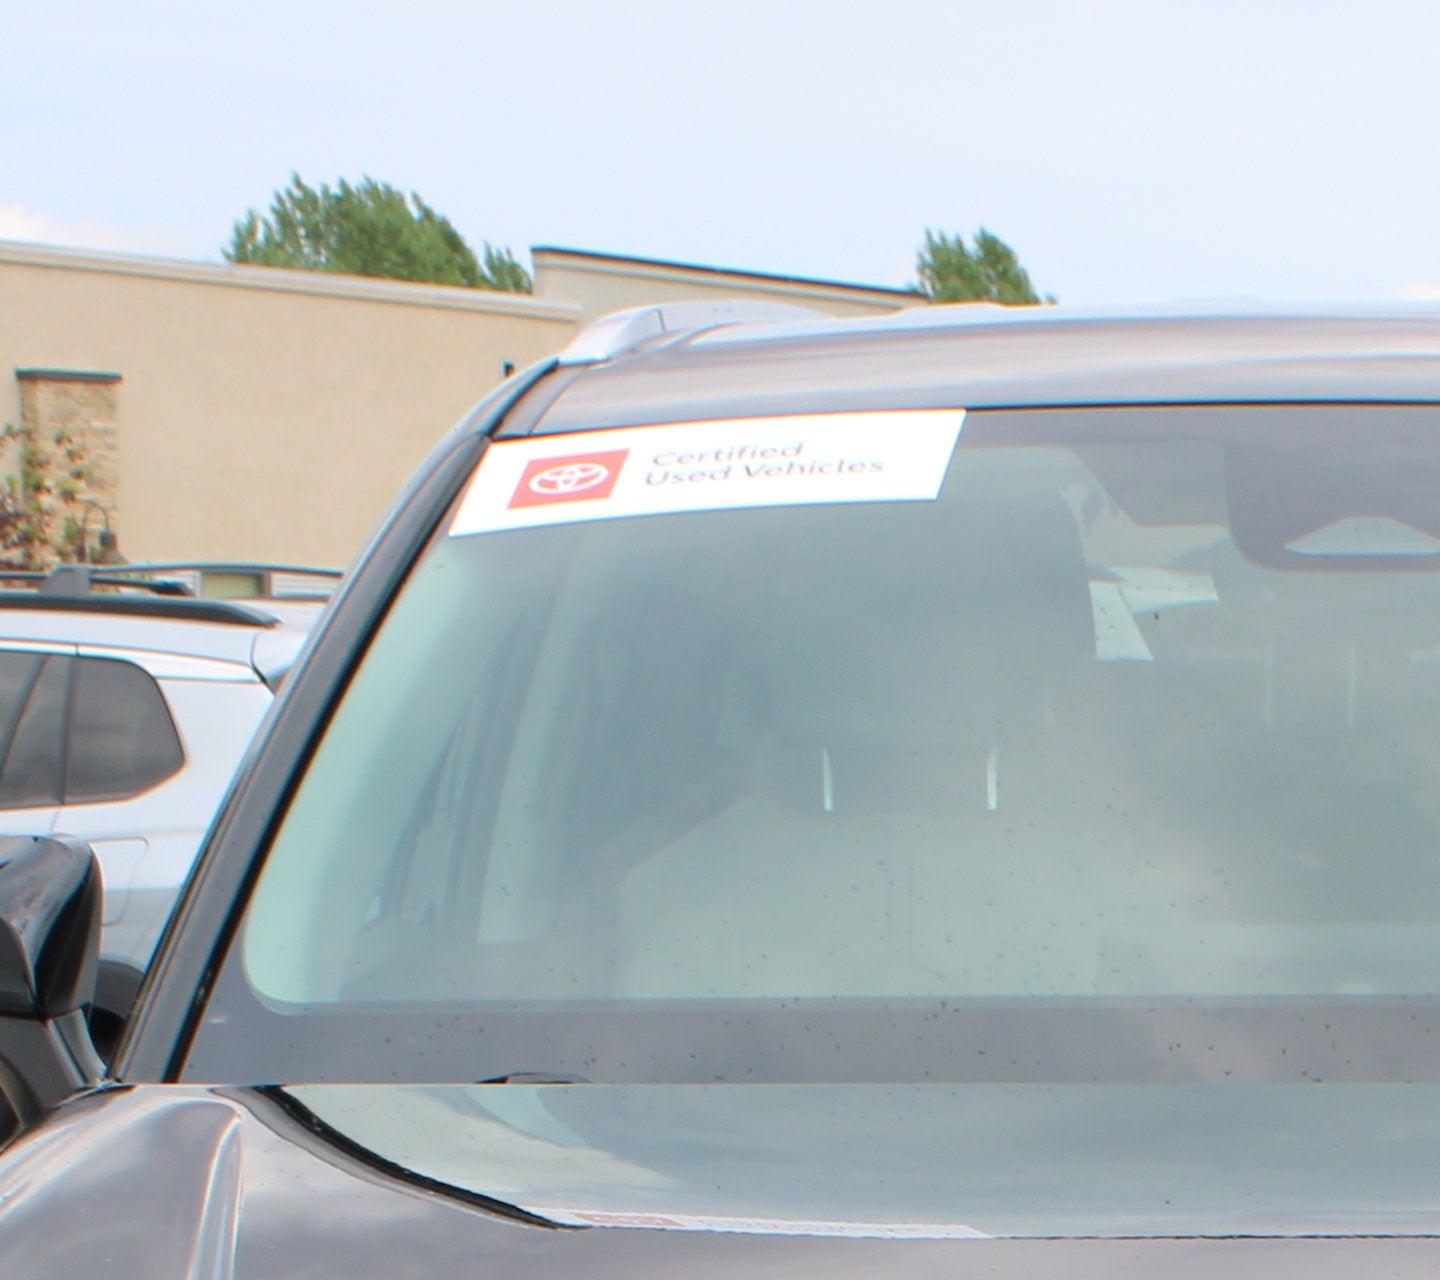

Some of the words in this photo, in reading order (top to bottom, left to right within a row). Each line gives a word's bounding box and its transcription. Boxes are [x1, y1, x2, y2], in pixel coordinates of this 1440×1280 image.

[653, 442, 804, 467] Certified
[645, 464, 733, 487] Used
[744, 458, 885, 478] Vehicles
